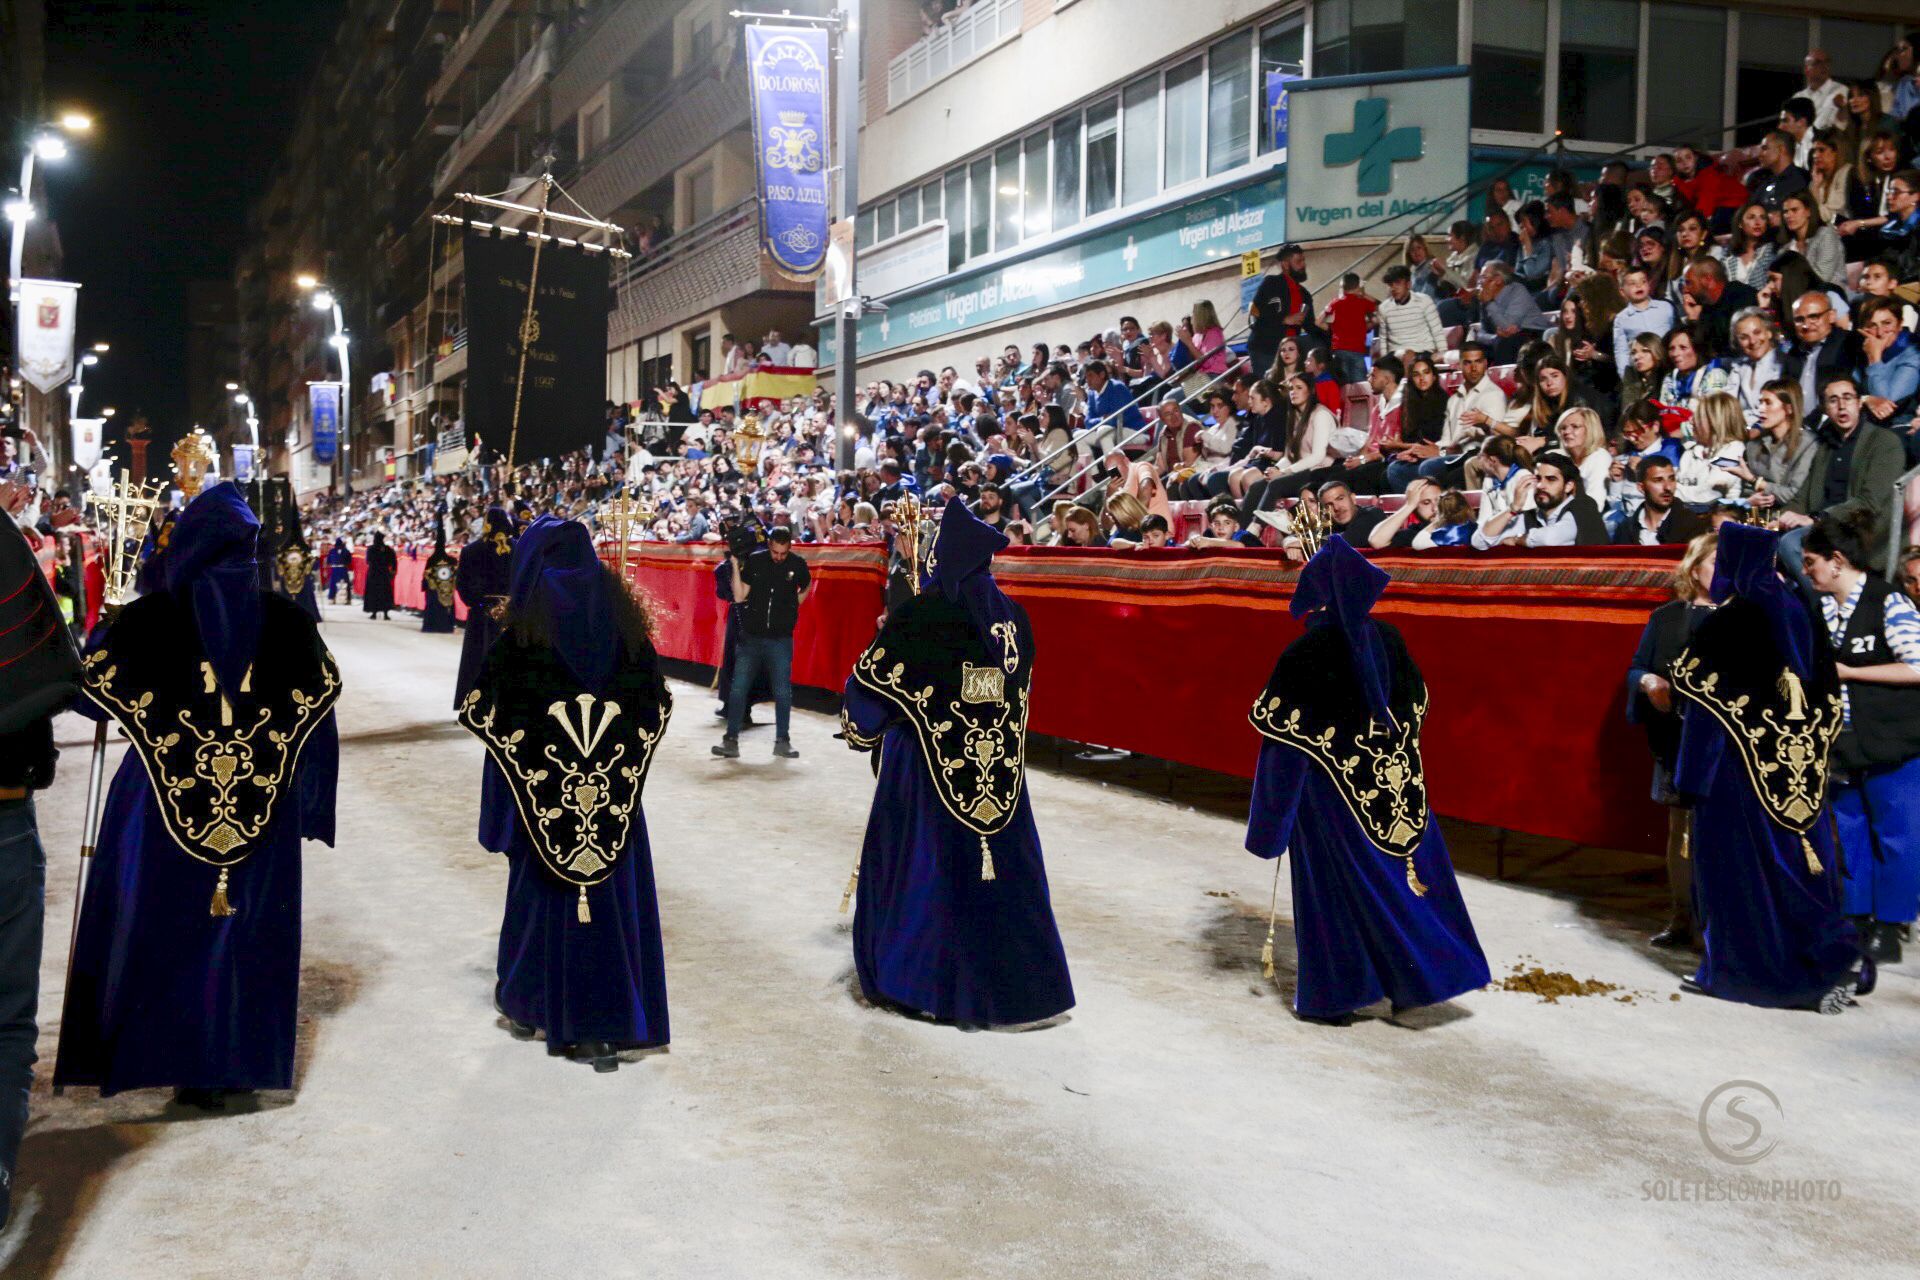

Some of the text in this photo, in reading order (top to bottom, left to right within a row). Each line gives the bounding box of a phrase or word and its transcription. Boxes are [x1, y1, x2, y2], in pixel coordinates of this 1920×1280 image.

[763, 45, 814, 72] MATER
[759, 75, 821, 94] DOLOROSA
[767, 185, 825, 204] PASO AZUL
[1296, 206, 1352, 226] Virgen
[1357, 200, 1384, 218] del
[1179, 208, 1265, 250] Virgen del Alcázar
[1246, 262, 1256, 275] 31
[945, 291, 978, 325] Virgen
[980, 278, 998, 311] del
[1850, 634, 1876, 654] 27
